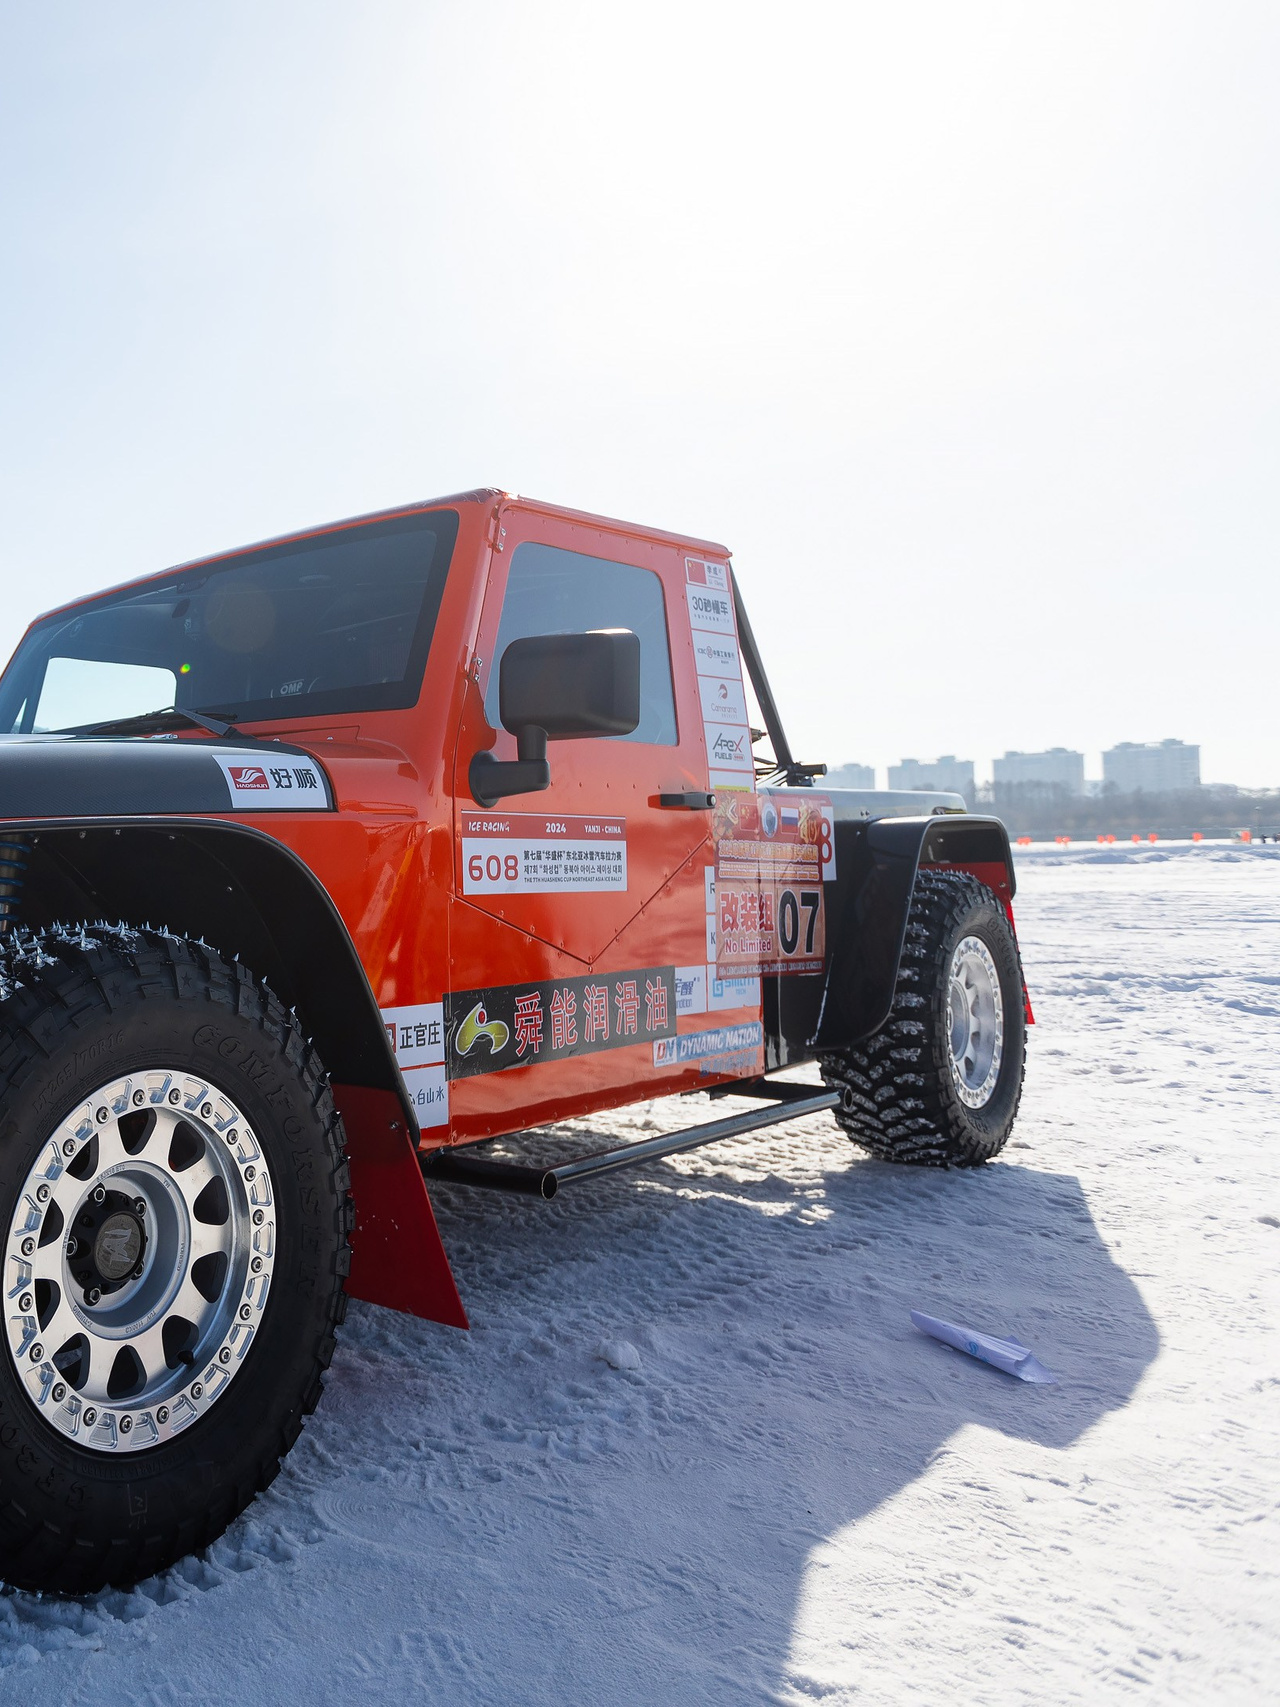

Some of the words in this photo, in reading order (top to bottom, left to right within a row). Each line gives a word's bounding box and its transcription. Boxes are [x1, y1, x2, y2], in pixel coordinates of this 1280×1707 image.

[691, 596, 729, 616] 30秒懂车
[280, 682, 304, 695] OMP
[269, 768, 318, 789] 好顺
[468, 821, 482, 832] ICE
[482, 821, 510, 832] RACING
[545, 822, 567, 834] 2024
[584, 824, 601, 834] YANJI
[604, 825, 622, 834] CHINA
[468, 854, 519, 882] 608
[720, 891, 775, 935] 改装组
[778, 888, 820, 955] 07
[725, 938, 738, 954] No
[740, 936, 772, 953] Limited
[513, 976, 670, 1057] 舜能润滑油
[399, 1020, 442, 1050] 正官庄
[680, 1032, 724, 1057] DYNAMIC
[726, 1026, 760, 1048] NATION
